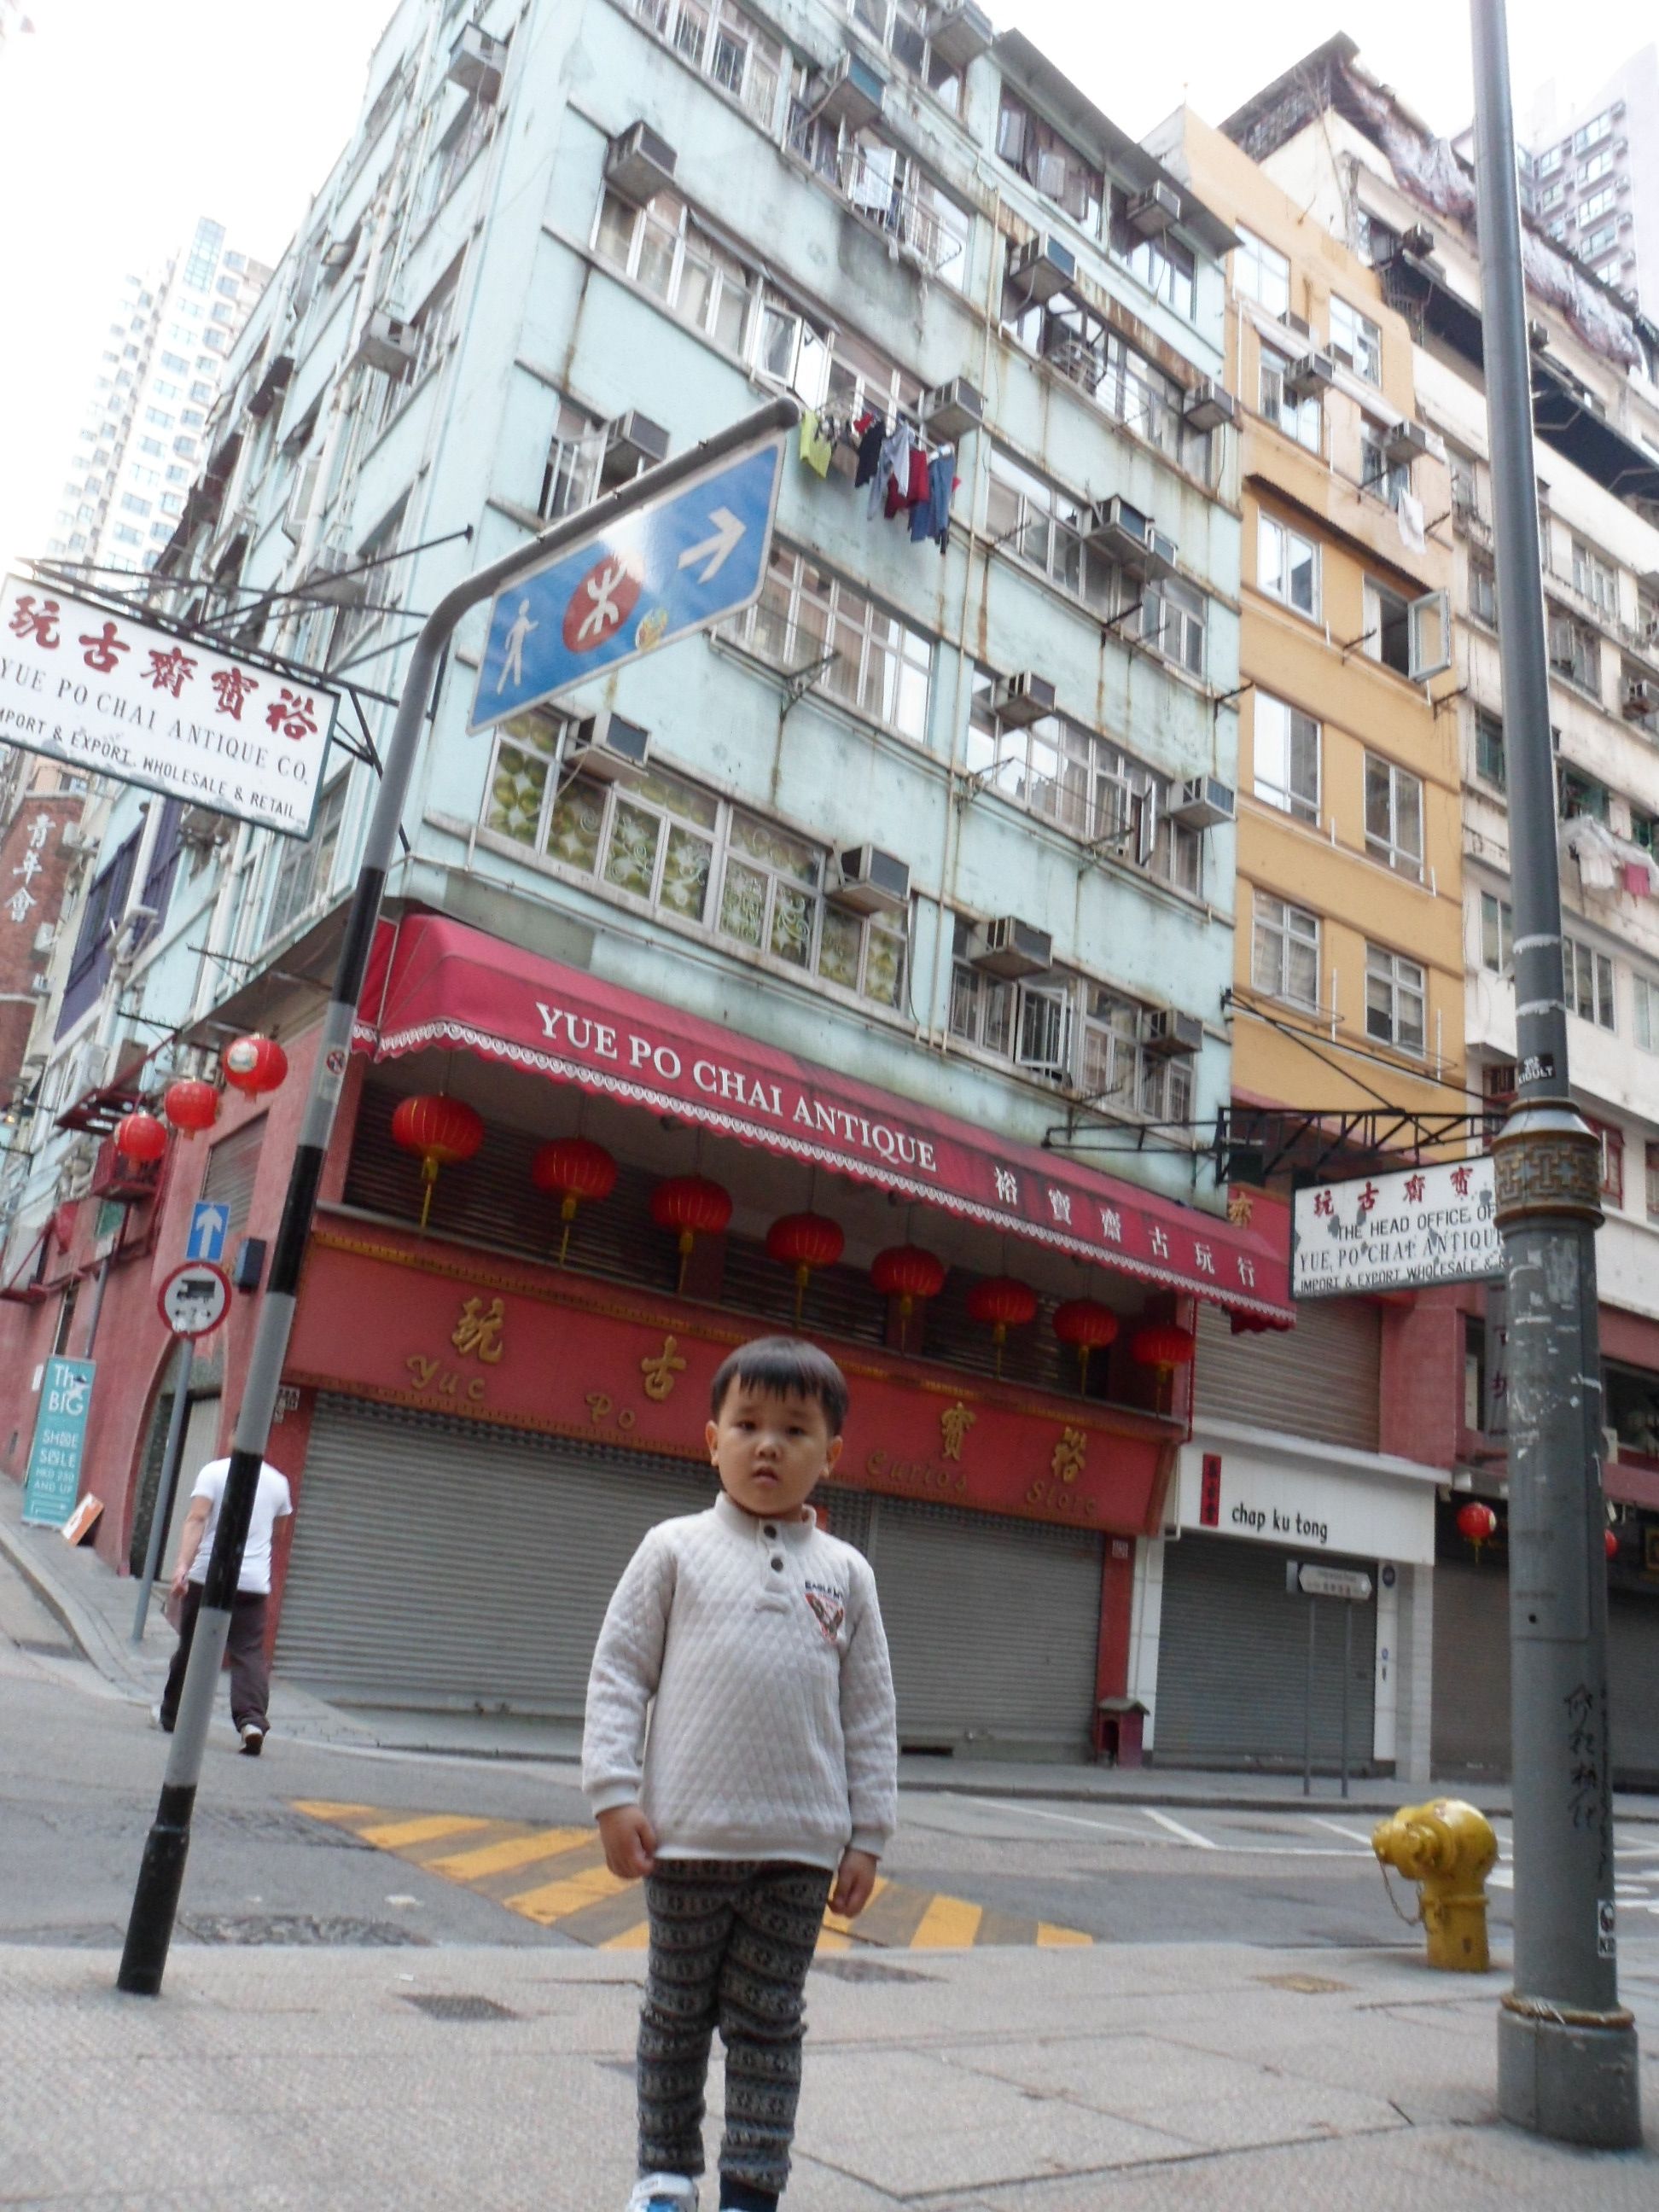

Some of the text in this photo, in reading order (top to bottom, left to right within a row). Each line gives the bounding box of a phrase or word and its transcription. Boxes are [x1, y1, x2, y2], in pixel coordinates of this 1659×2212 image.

[2, 658, 46, 692] YUE
[57, 677, 89, 706] PO
[96, 692, 157, 731] CHAI
[169, 719, 269, 768] ANTIQUE
[53, 725, 62, 742] &
[143, 755, 227, 795] WHOLESALE
[234, 786, 243, 802] &
[251, 792, 295, 819] RETAIL
[535, 1002, 937, 1172] YUE PO CHAI ANTIQUE
[1338, 1223, 1363, 1242] THE
[1371, 1215, 1410, 1237] HEAD
[1301, 1277, 1338, 1294] IMPORT
[1358, 1269, 1400, 1289] EXPORT
[1406, 1259, 1476, 1281] WHOLESALE
[1338, 1249, 1359, 1268] PO
[49, 1390, 84, 1417] BIG
[585, 1392, 637, 1430] Po
[1026, 1480, 1097, 1516] Store
[1231, 1500, 1328, 1544] chap ku tong
